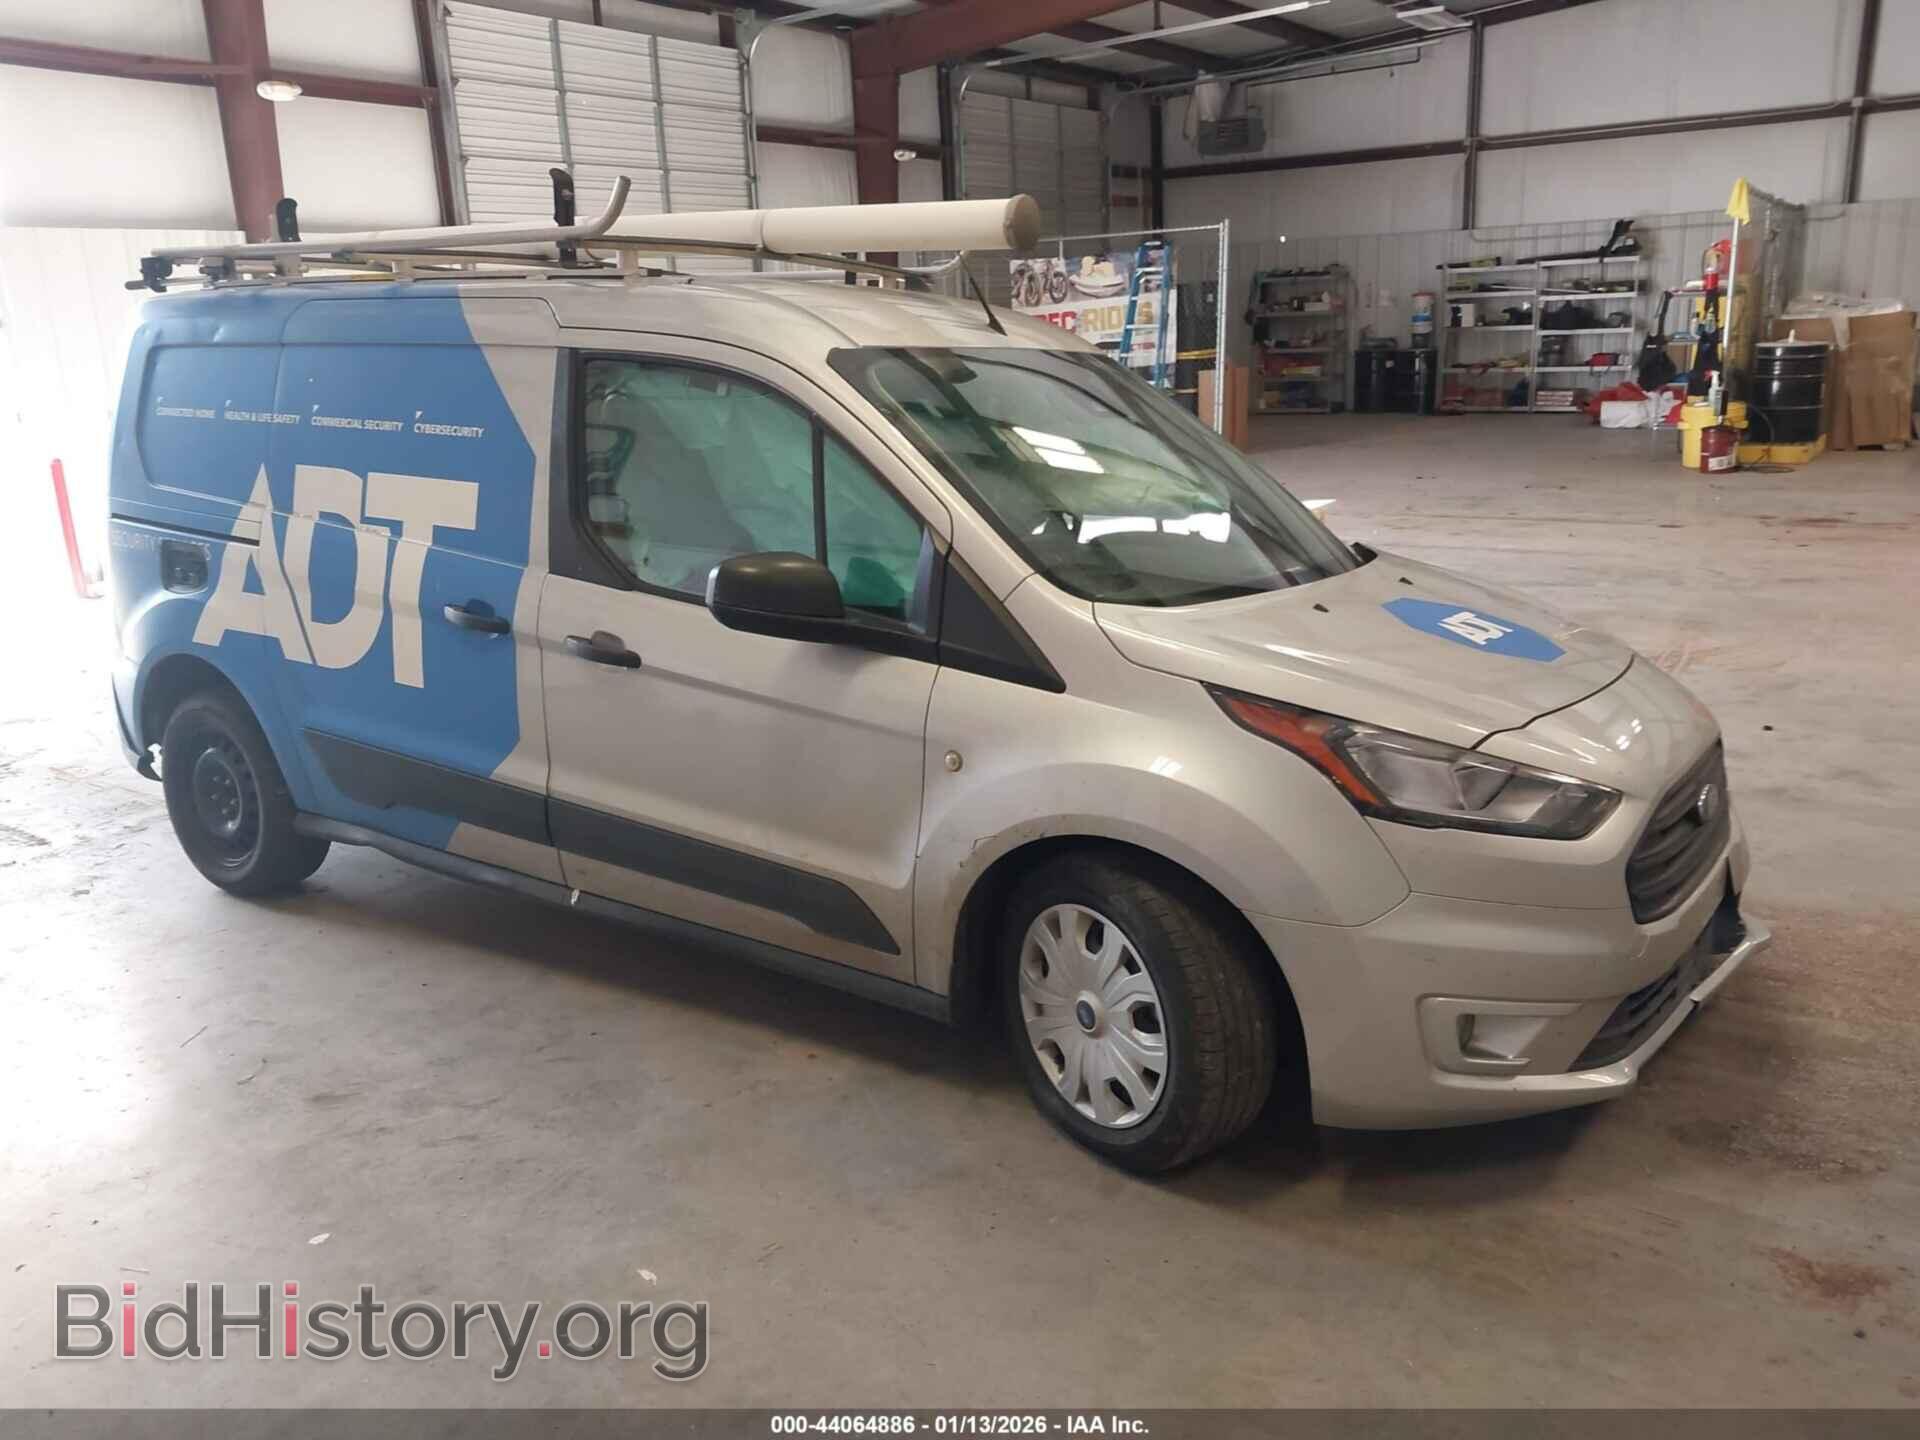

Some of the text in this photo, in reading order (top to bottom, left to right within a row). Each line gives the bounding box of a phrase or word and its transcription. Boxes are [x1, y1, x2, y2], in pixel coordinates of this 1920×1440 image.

[1033, 310, 1077, 335] EC
[224, 410, 250, 421] HEALTH
[273, 413, 300, 424] SAFETY
[312, 416, 404, 431] COMMERCIAL SECURITY
[414, 423, 485, 438] CYBERSECURITY
[192, 463, 479, 688] ADT
[1438, 611, 1514, 645] ADT
